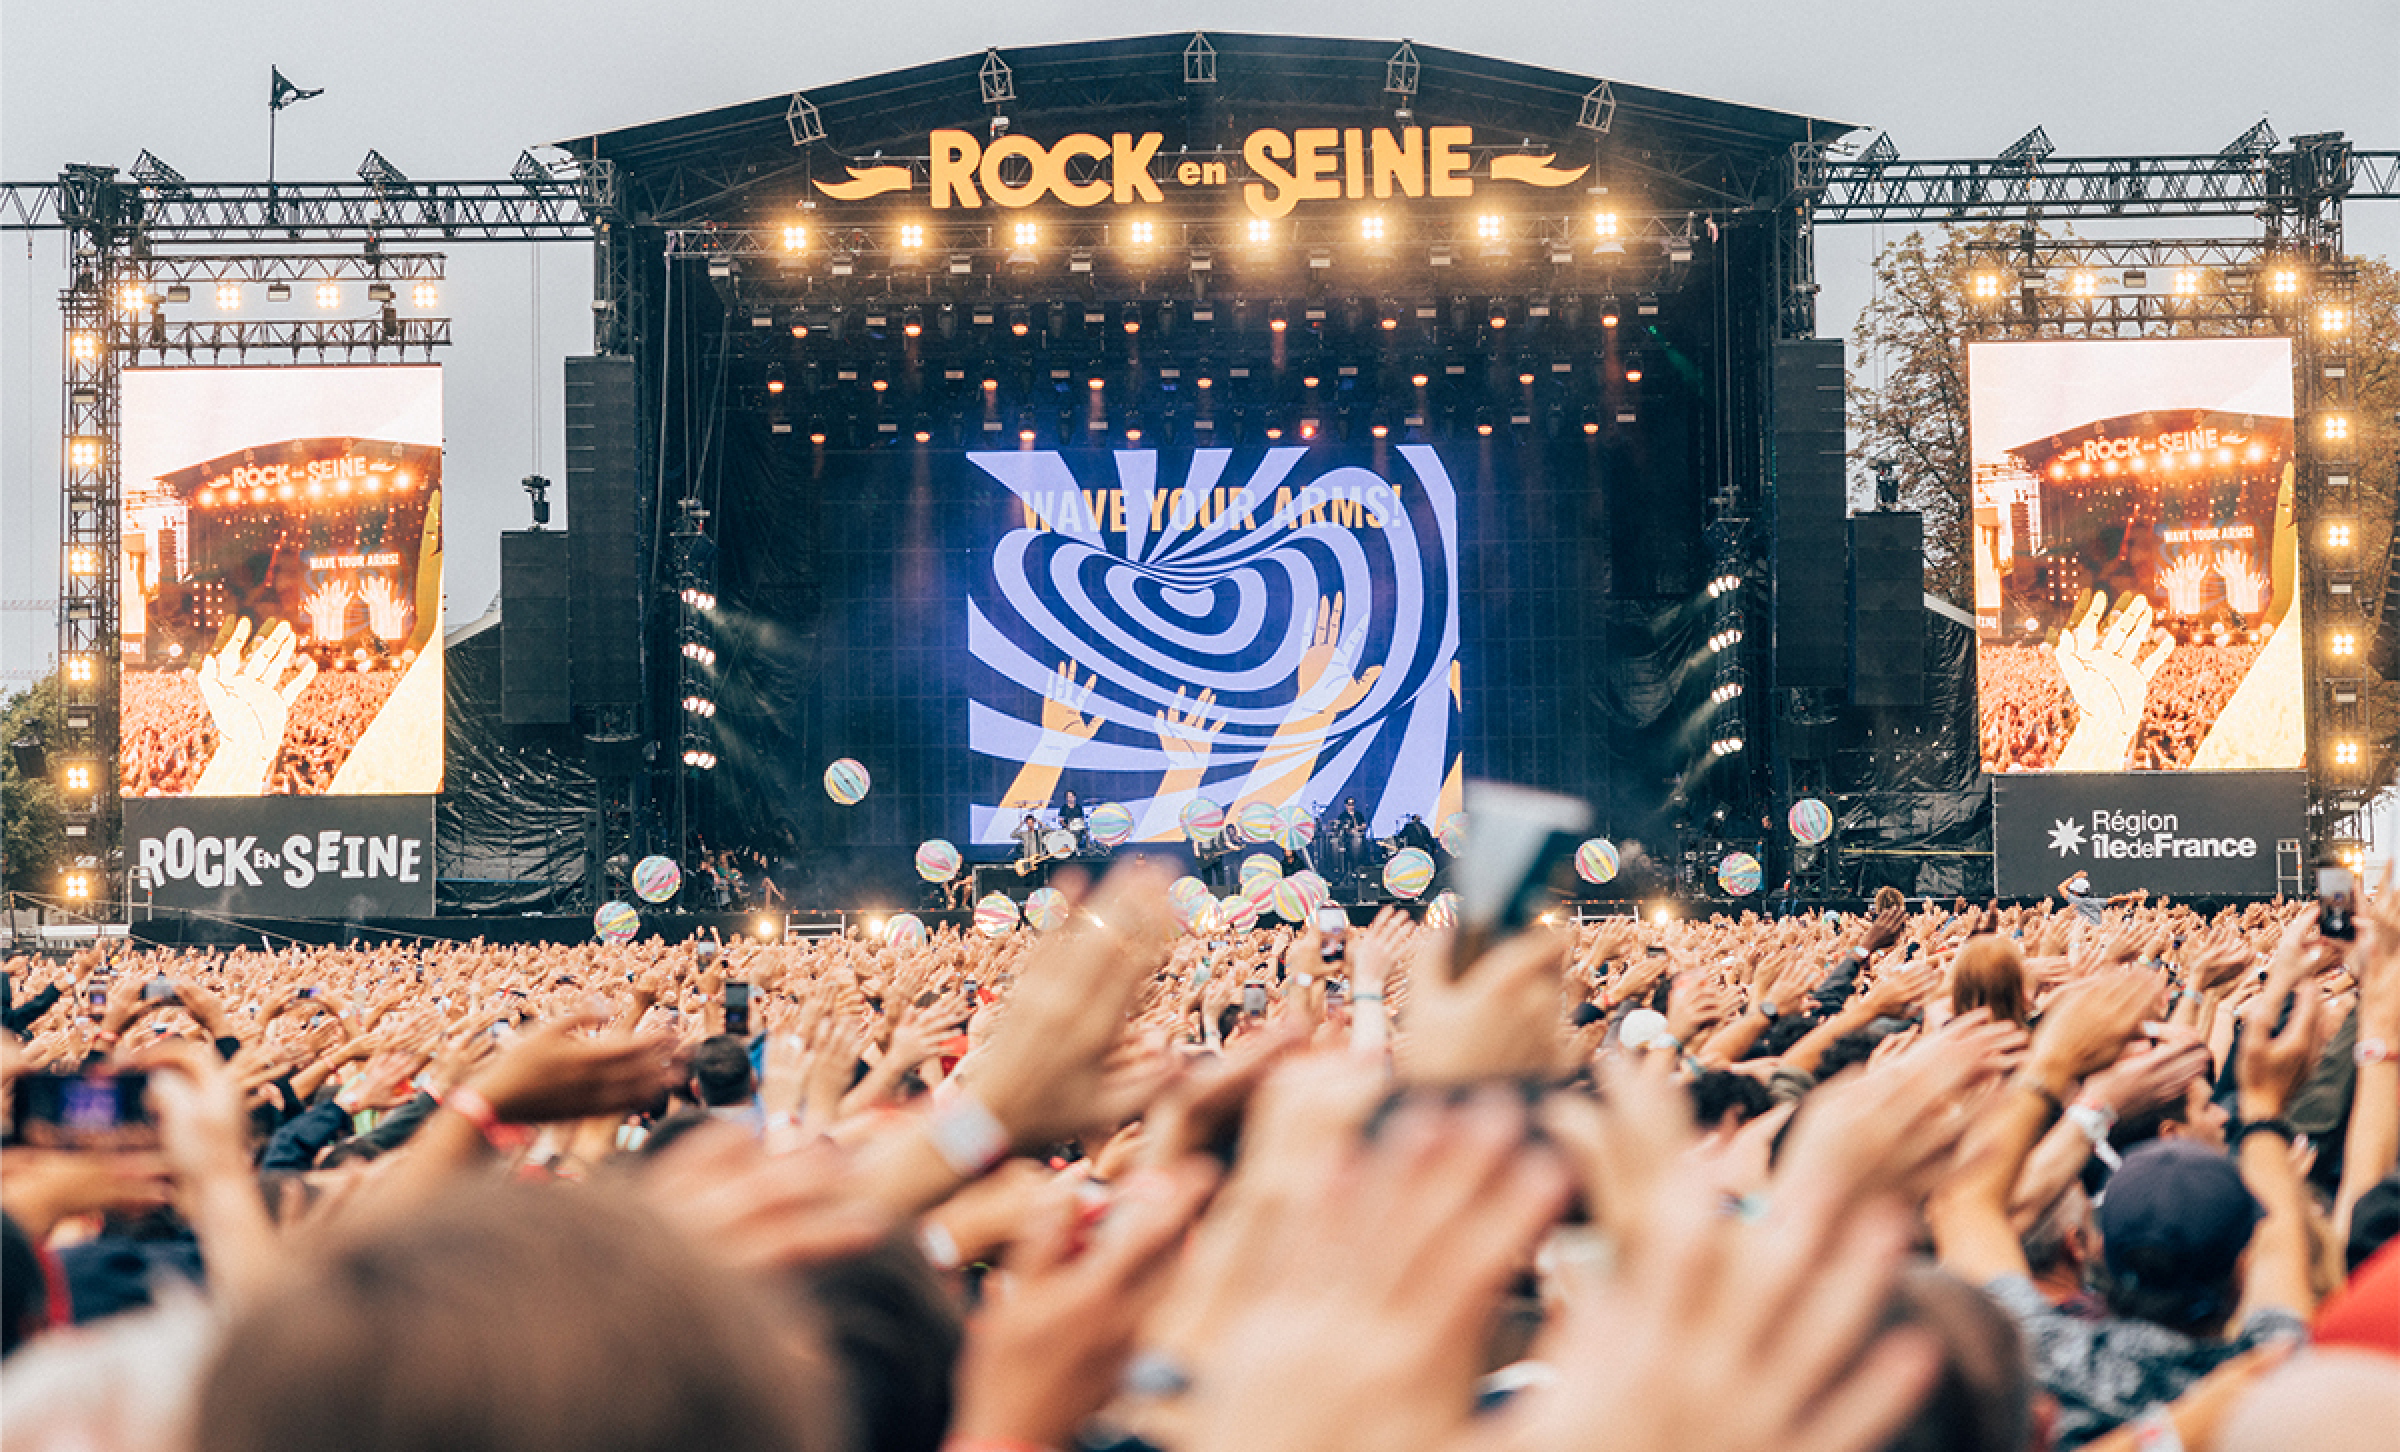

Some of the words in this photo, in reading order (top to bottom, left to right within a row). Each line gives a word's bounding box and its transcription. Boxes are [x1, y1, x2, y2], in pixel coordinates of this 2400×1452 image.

[930, 128, 1164, 208] ROCK
[1177, 158, 1227, 187] en
[1242, 126, 1474, 219] SEINE
[2083, 438, 2140, 461] ROCK
[2158, 429, 2219, 454] SEINE
[233, 465, 290, 488] ROCK
[307, 456, 367, 482] SEINE
[1022, 488, 1129, 533] WAVE
[1146, 487, 1256, 532] YOUR
[1273, 484, 1403, 529] ARMS!
[2092, 809, 2179, 836] Région
[139, 826, 262, 888] ROCK
[253, 848, 281, 868] EN
[282, 830, 422, 888] SEINE
